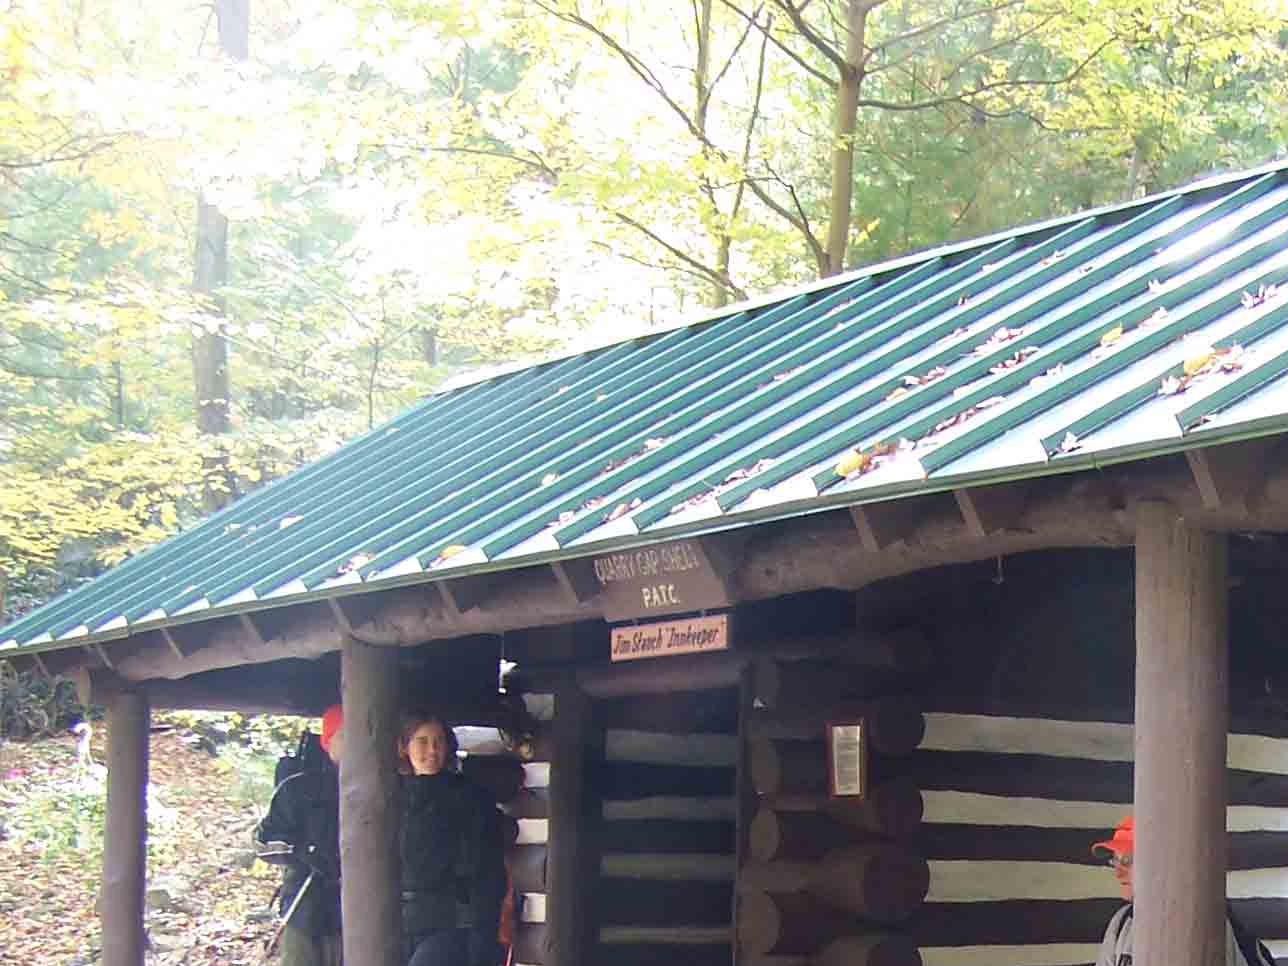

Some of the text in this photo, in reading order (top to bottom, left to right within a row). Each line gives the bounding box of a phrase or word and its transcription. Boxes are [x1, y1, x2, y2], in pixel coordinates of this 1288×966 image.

[594, 554, 635, 585] QUARRY
[638, 550, 658, 577] GAP
[613, 633, 630, 654] Jim
